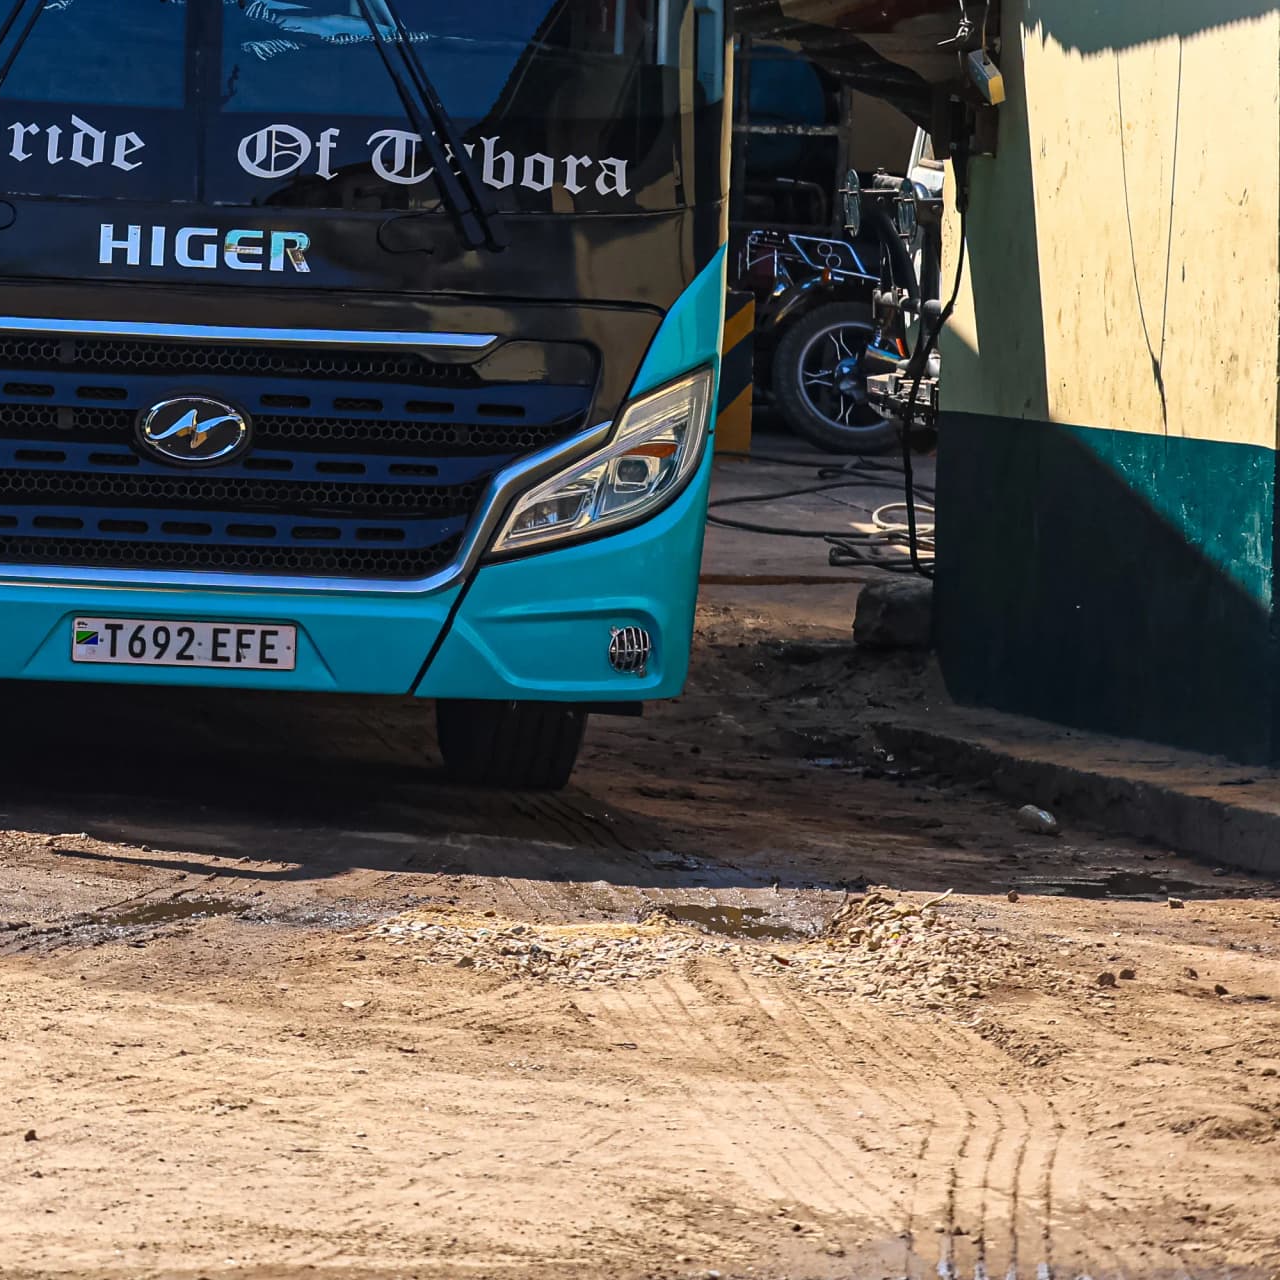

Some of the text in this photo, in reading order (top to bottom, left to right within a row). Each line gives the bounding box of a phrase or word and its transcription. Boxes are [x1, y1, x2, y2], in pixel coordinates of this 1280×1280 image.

[237, 123, 340, 181] Of
[98, 223, 312, 273] HIGER
[105, 623, 279, 664] T692 EFE
